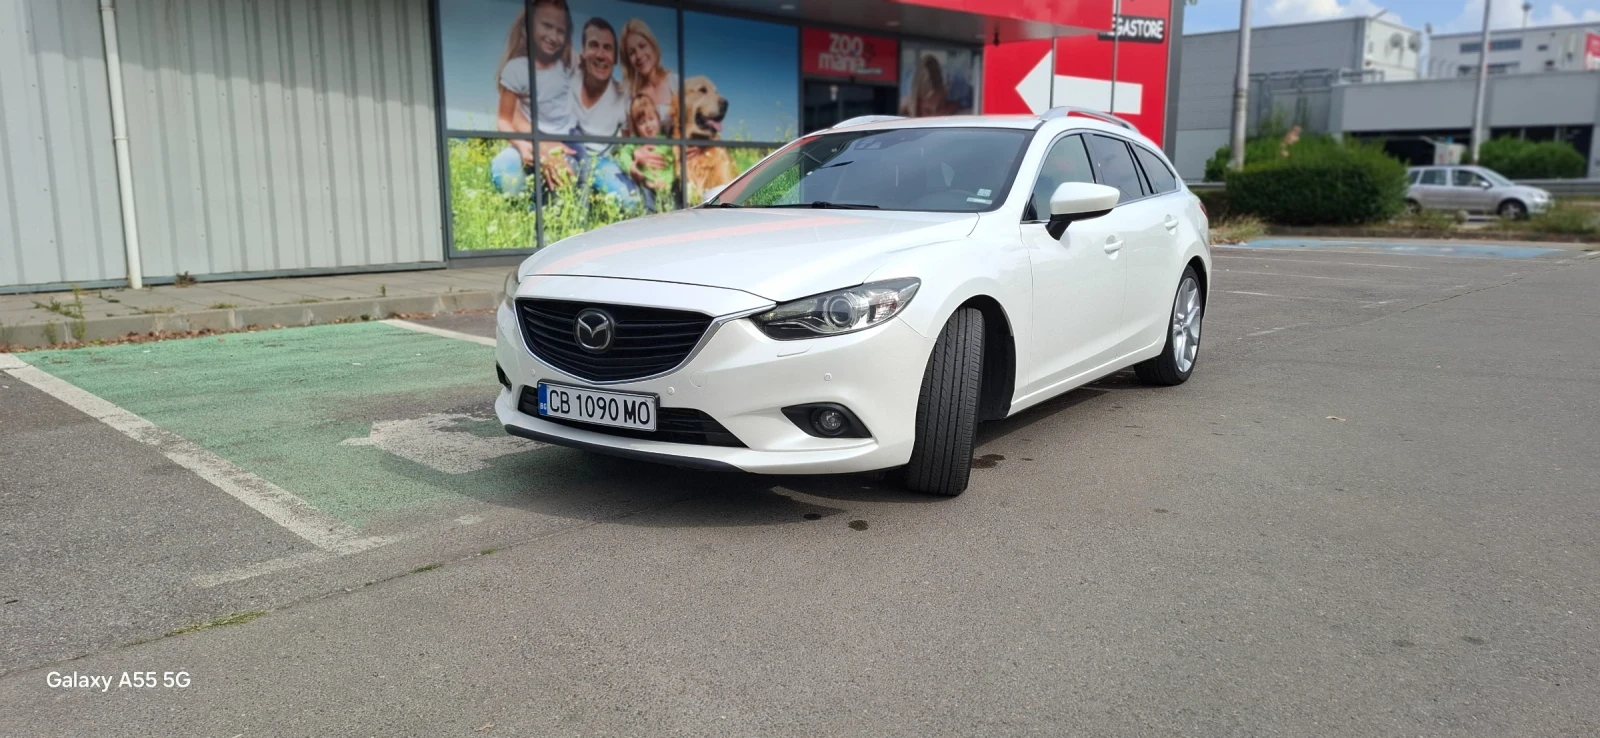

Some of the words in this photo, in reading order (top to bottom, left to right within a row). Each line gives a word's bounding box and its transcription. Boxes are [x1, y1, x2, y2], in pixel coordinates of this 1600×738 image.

[1101, 17, 1164, 39] EGASTORE
[549, 389, 571, 414] CB
[576, 394, 619, 421] 1090
[623, 399, 651, 425] MO
